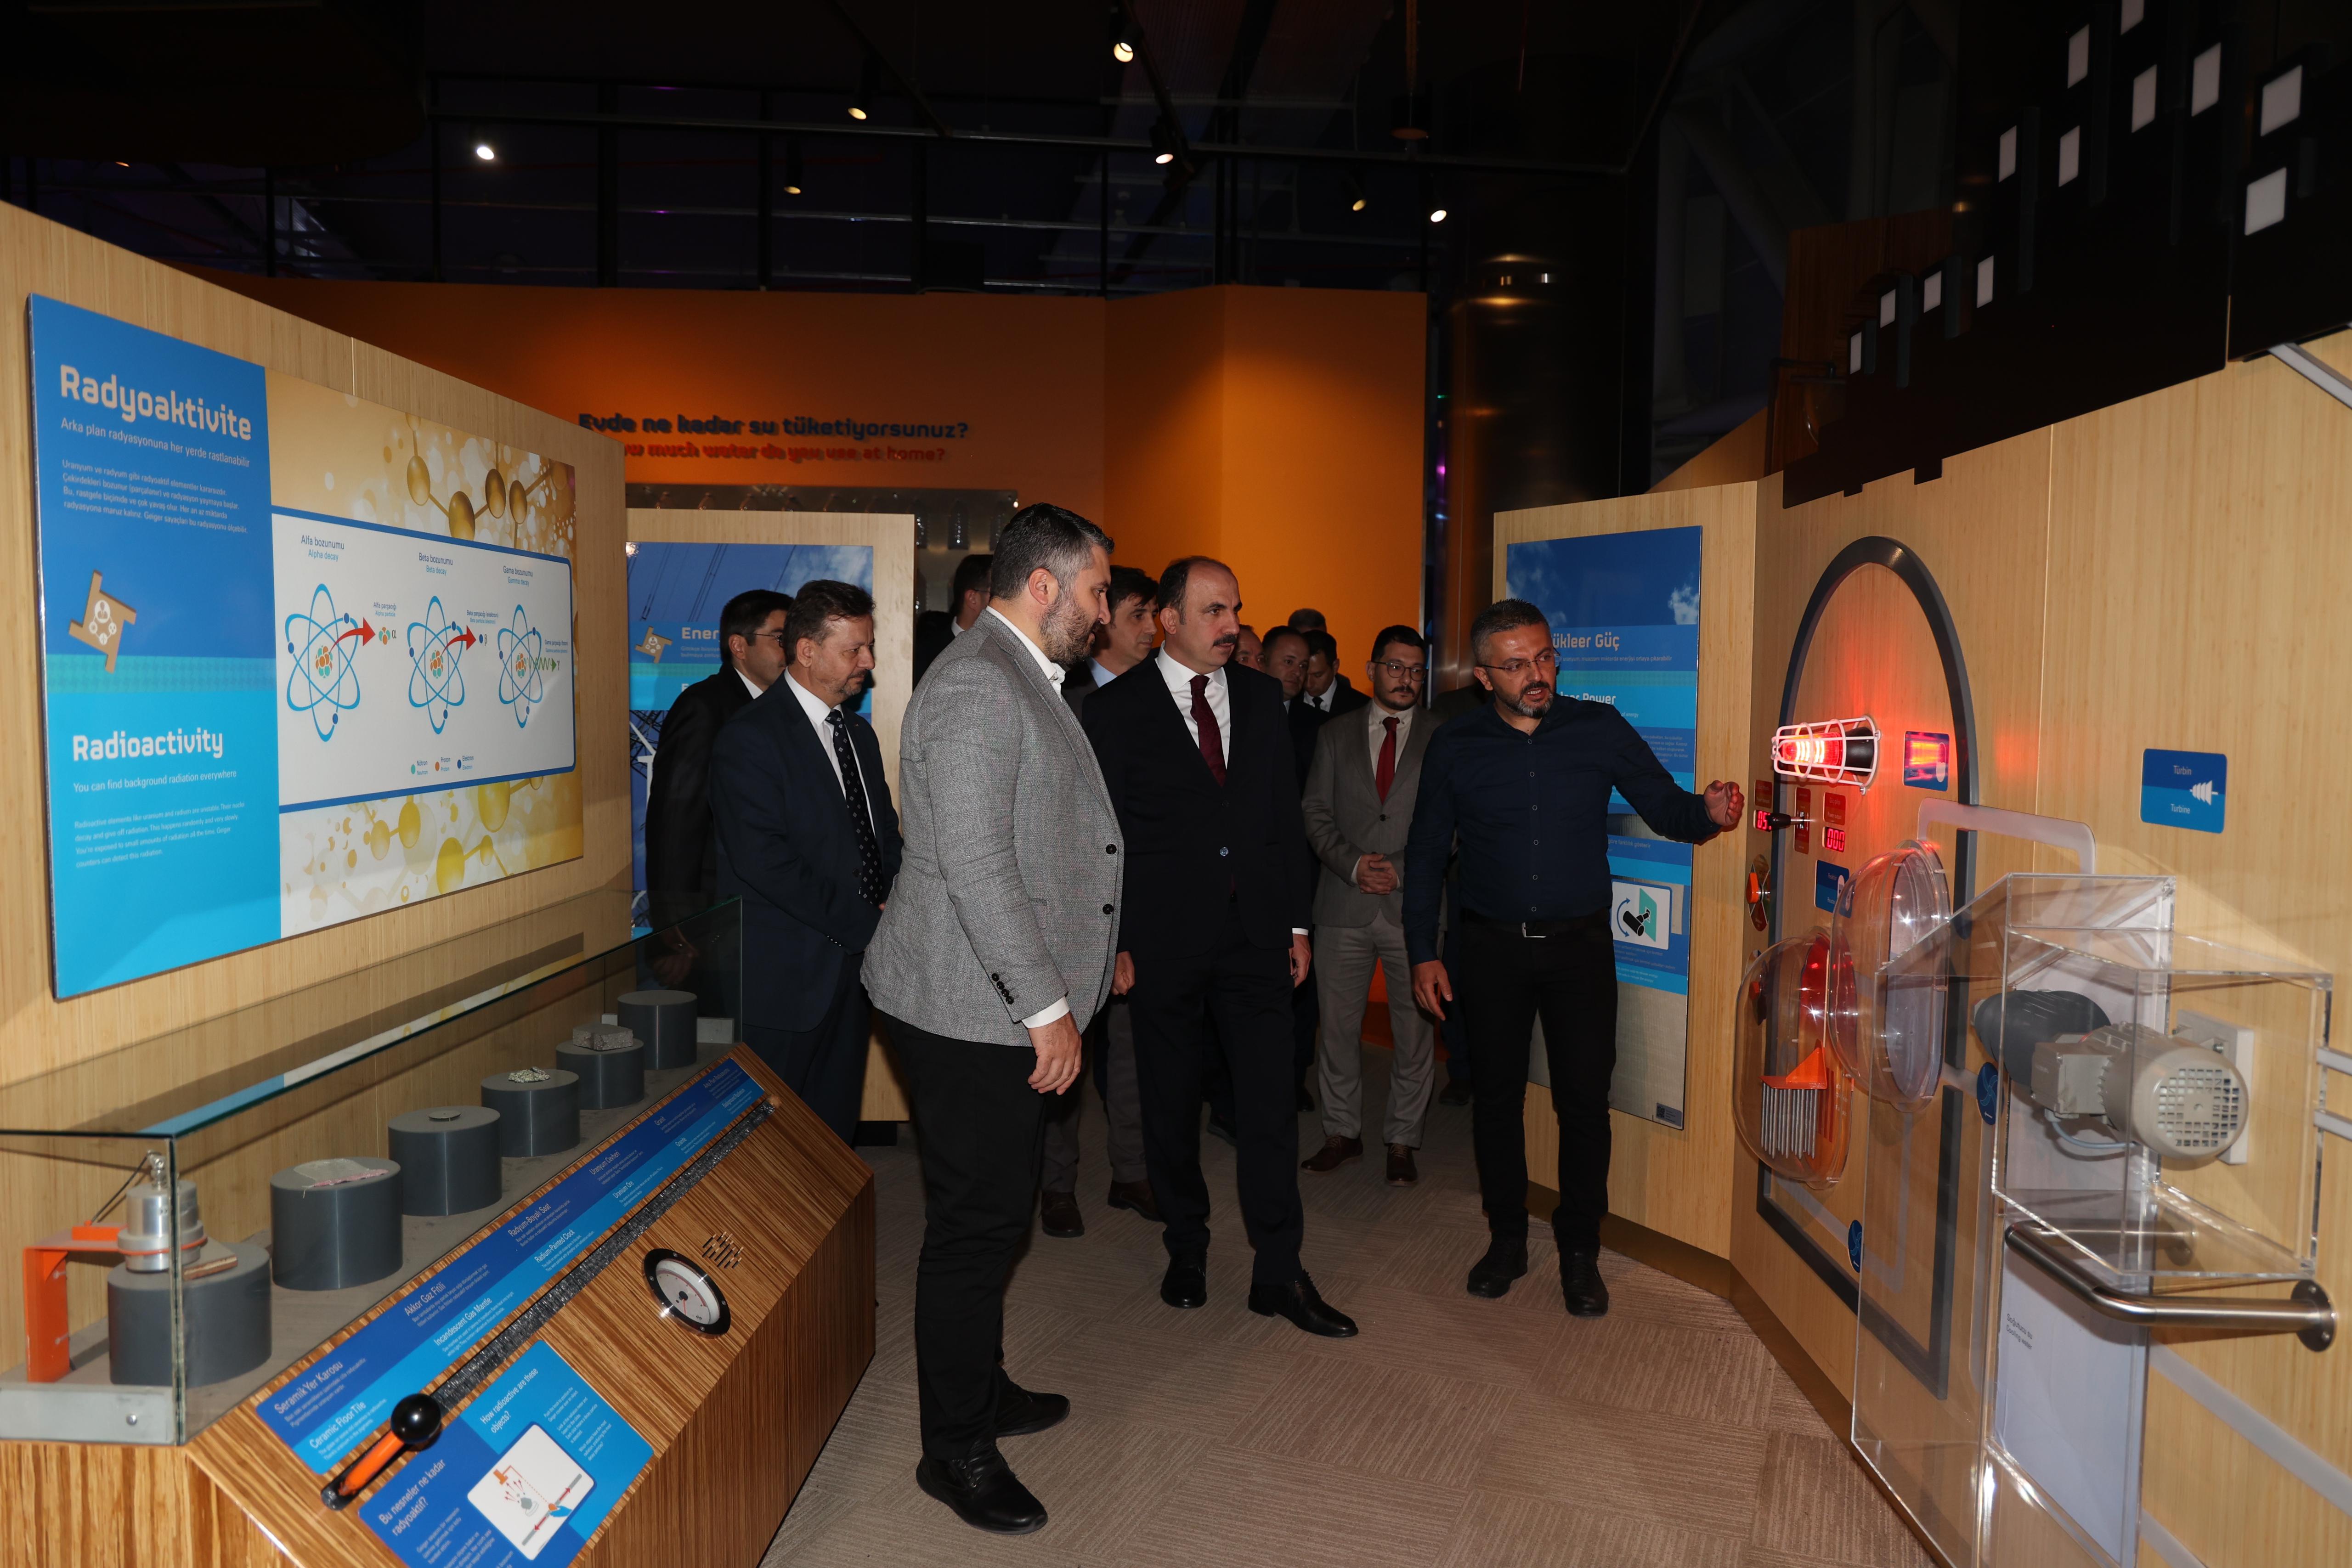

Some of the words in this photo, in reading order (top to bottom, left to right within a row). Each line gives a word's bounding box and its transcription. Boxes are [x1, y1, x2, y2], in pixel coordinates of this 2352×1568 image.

[60, 364, 251, 440] Radyoaktivite
[579, 412, 636, 432] Evde
[643, 417, 672, 433] ne
[678, 414, 745, 434] kadar
[750, 420, 779, 435] su
[783, 416, 968, 441] tüketiyorsunuz?
[61, 417, 83, 432] Arka
[86, 423, 106, 437] plan
[109, 430, 168, 450] radyasyonuna
[170, 441, 183, 453] her
[186, 447, 206, 458] yerde
[209, 452, 249, 467] rastlanabilir
[647, 442, 699, 457] much
[703, 444, 758, 458] water
[761, 443, 784, 459] do
[788, 447, 820, 463] you
[826, 447, 857, 459] use
[863, 446, 881, 459] at
[887, 446, 945, 461] home?
[301, 535, 313, 545] Alfa
[315, 537, 345, 550] bozunumu
[308, 549, 323, 559] Alpha
[324, 551, 339, 562] decay
[419, 553, 429, 562] Beta
[430, 554, 453, 565] bozunumu
[435, 566, 447, 575] decay
[503, 565, 514, 574] Gama
[514, 567, 533, 577] bozunumu
[682, 627, 720, 641] Ener
[1553, 633, 1591, 648] ükleer
[1595, 632, 1620, 651] Güç
[73, 727, 222, 761] Radioactivity
[74, 783, 89, 792] You
[107, 779, 122, 789] find
[124, 775, 167, 788] background
[169, 773, 198, 783] radiation
[200, 769, 236, 780] everywhere
[2171, 803, 2190, 814] Turbine
[1827, 828, 1845, 851] 000
[508, 1210, 541, 1236] Radyum-Boyalı
[538, 1203, 551, 1213] Saat
[534, 1236, 565, 1263] Radium-Painted
[562, 1229, 575, 1239] Clock
[404, 1300, 422, 1316] Akkor
[420, 1292, 434, 1303] Gaz
[430, 1281, 446, 1295] Fitili
[433, 1318, 467, 1345] Incandescent
[464, 1311, 476, 1320] Gas
[473, 1298, 492, 1312] Mantle
[480, 1410, 494, 1424] How
[493, 1387, 519, 1412] radioactive
[517, 1380, 526, 1389] are
[524, 1368, 538, 1382] these
[309, 1425, 338, 1448] Ceramic
[335, 1411, 354, 1427] Floor
[350, 1401, 366, 1413] Tile
[491, 1410, 510, 1433] objects?
[378, 1512, 392, 1524] Bu
[391, 1484, 419, 1514] nesneler
[418, 1477, 428, 1487] ne
[424, 1459, 445, 1478] kadar
[392, 1496, 428, 1536] radyoaktif?
